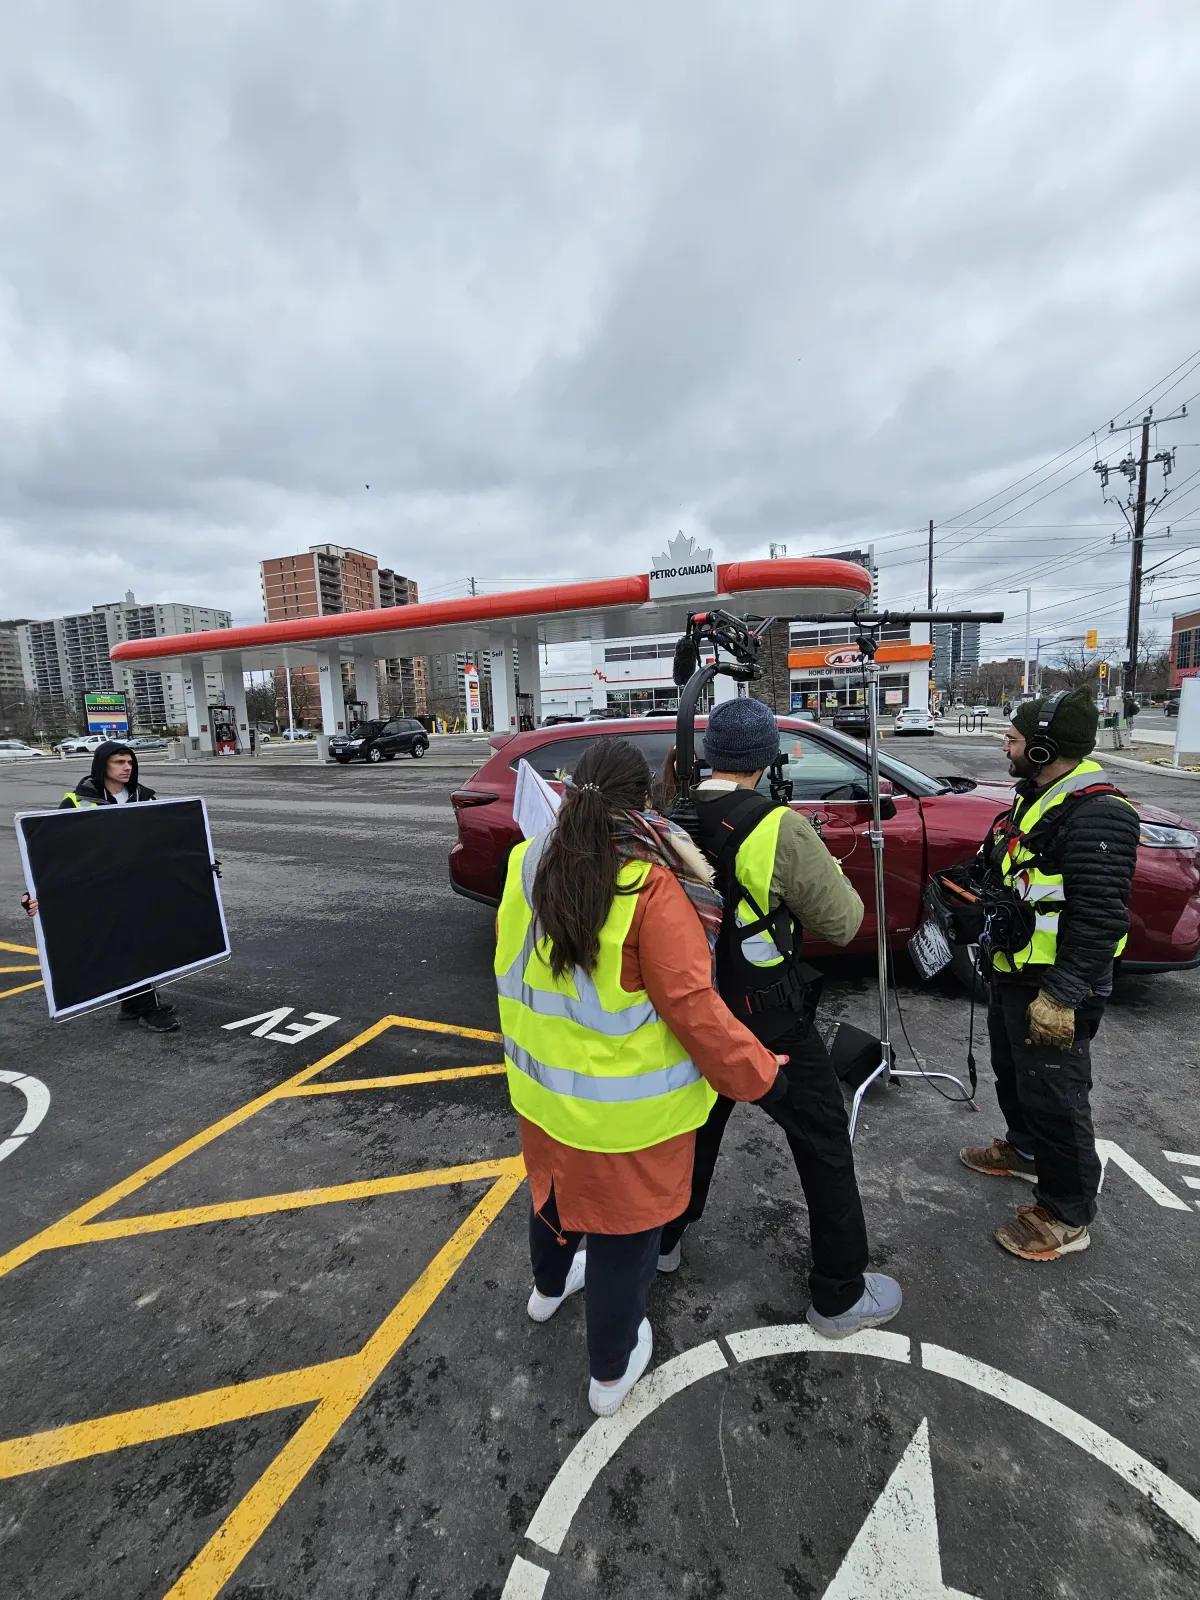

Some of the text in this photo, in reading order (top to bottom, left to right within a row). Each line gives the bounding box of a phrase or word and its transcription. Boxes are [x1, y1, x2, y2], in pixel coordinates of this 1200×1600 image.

[491, 650, 503, 658] Self
[832, 653, 867, 664] A&W
[319, 665, 329, 673] Self
[834, 667, 845, 675] THE
